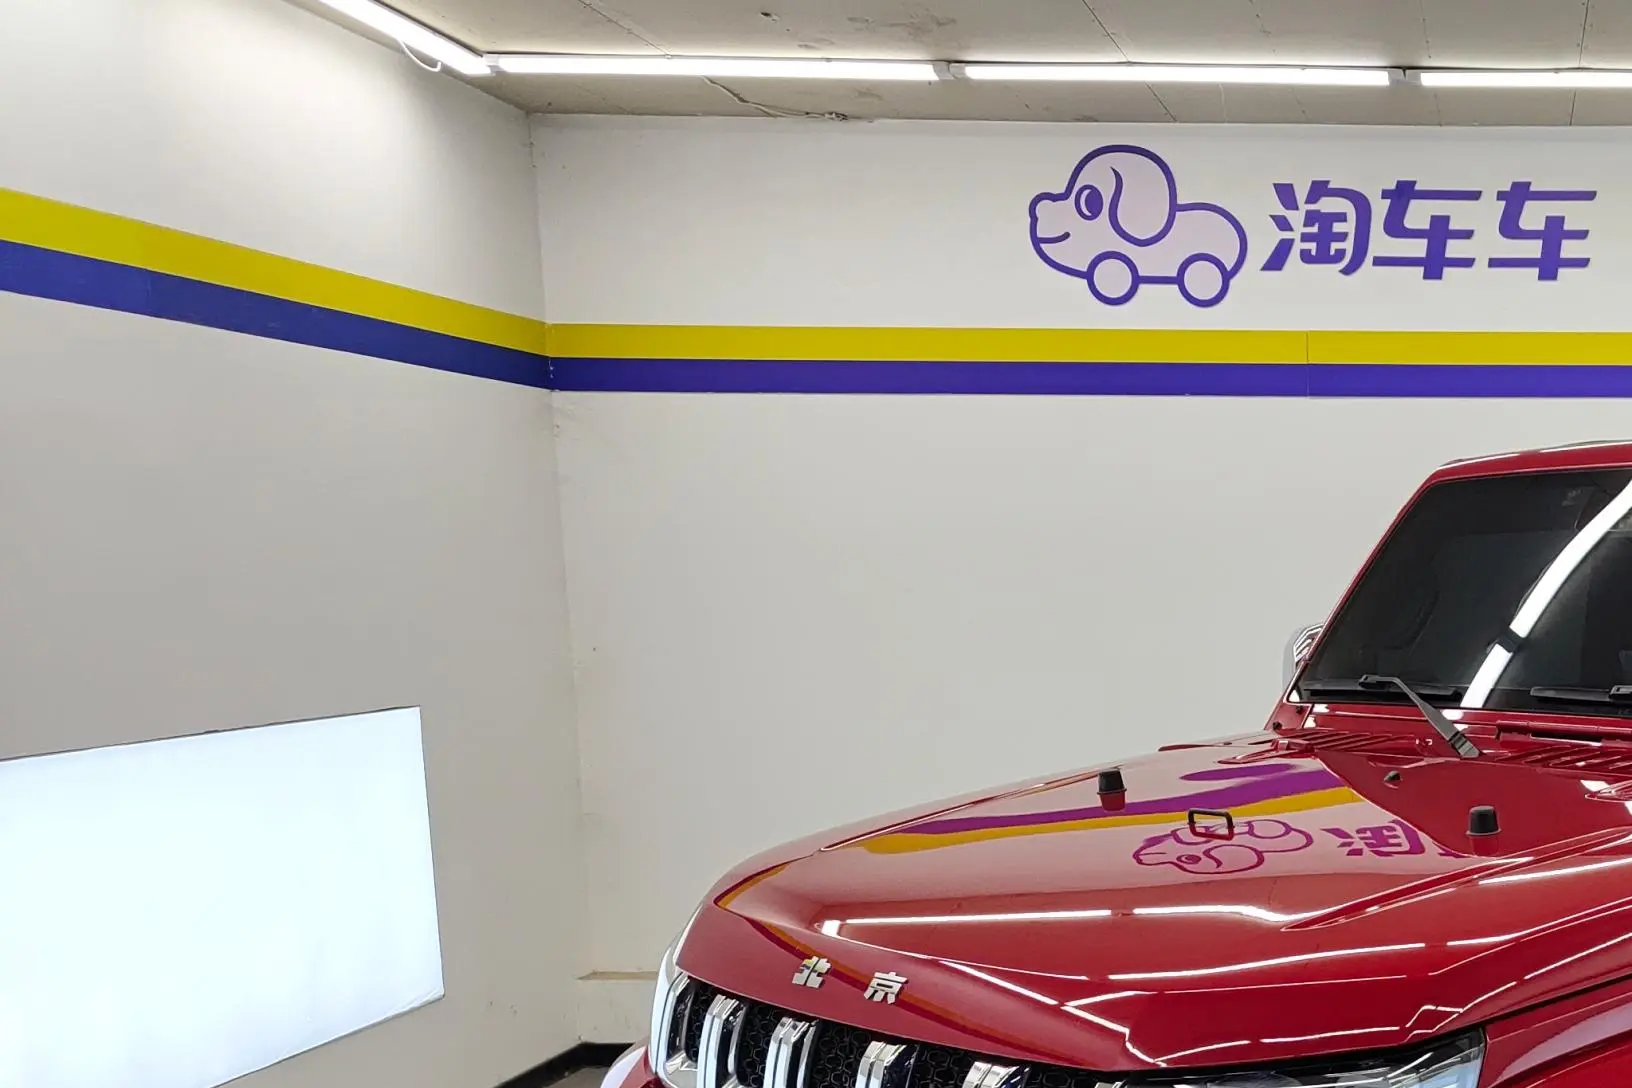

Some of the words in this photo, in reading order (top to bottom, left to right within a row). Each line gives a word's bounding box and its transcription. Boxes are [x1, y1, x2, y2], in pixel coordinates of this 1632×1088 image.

[1259, 177, 1598, 282] 淘车车
[791, 955, 909, 1005] 北京
